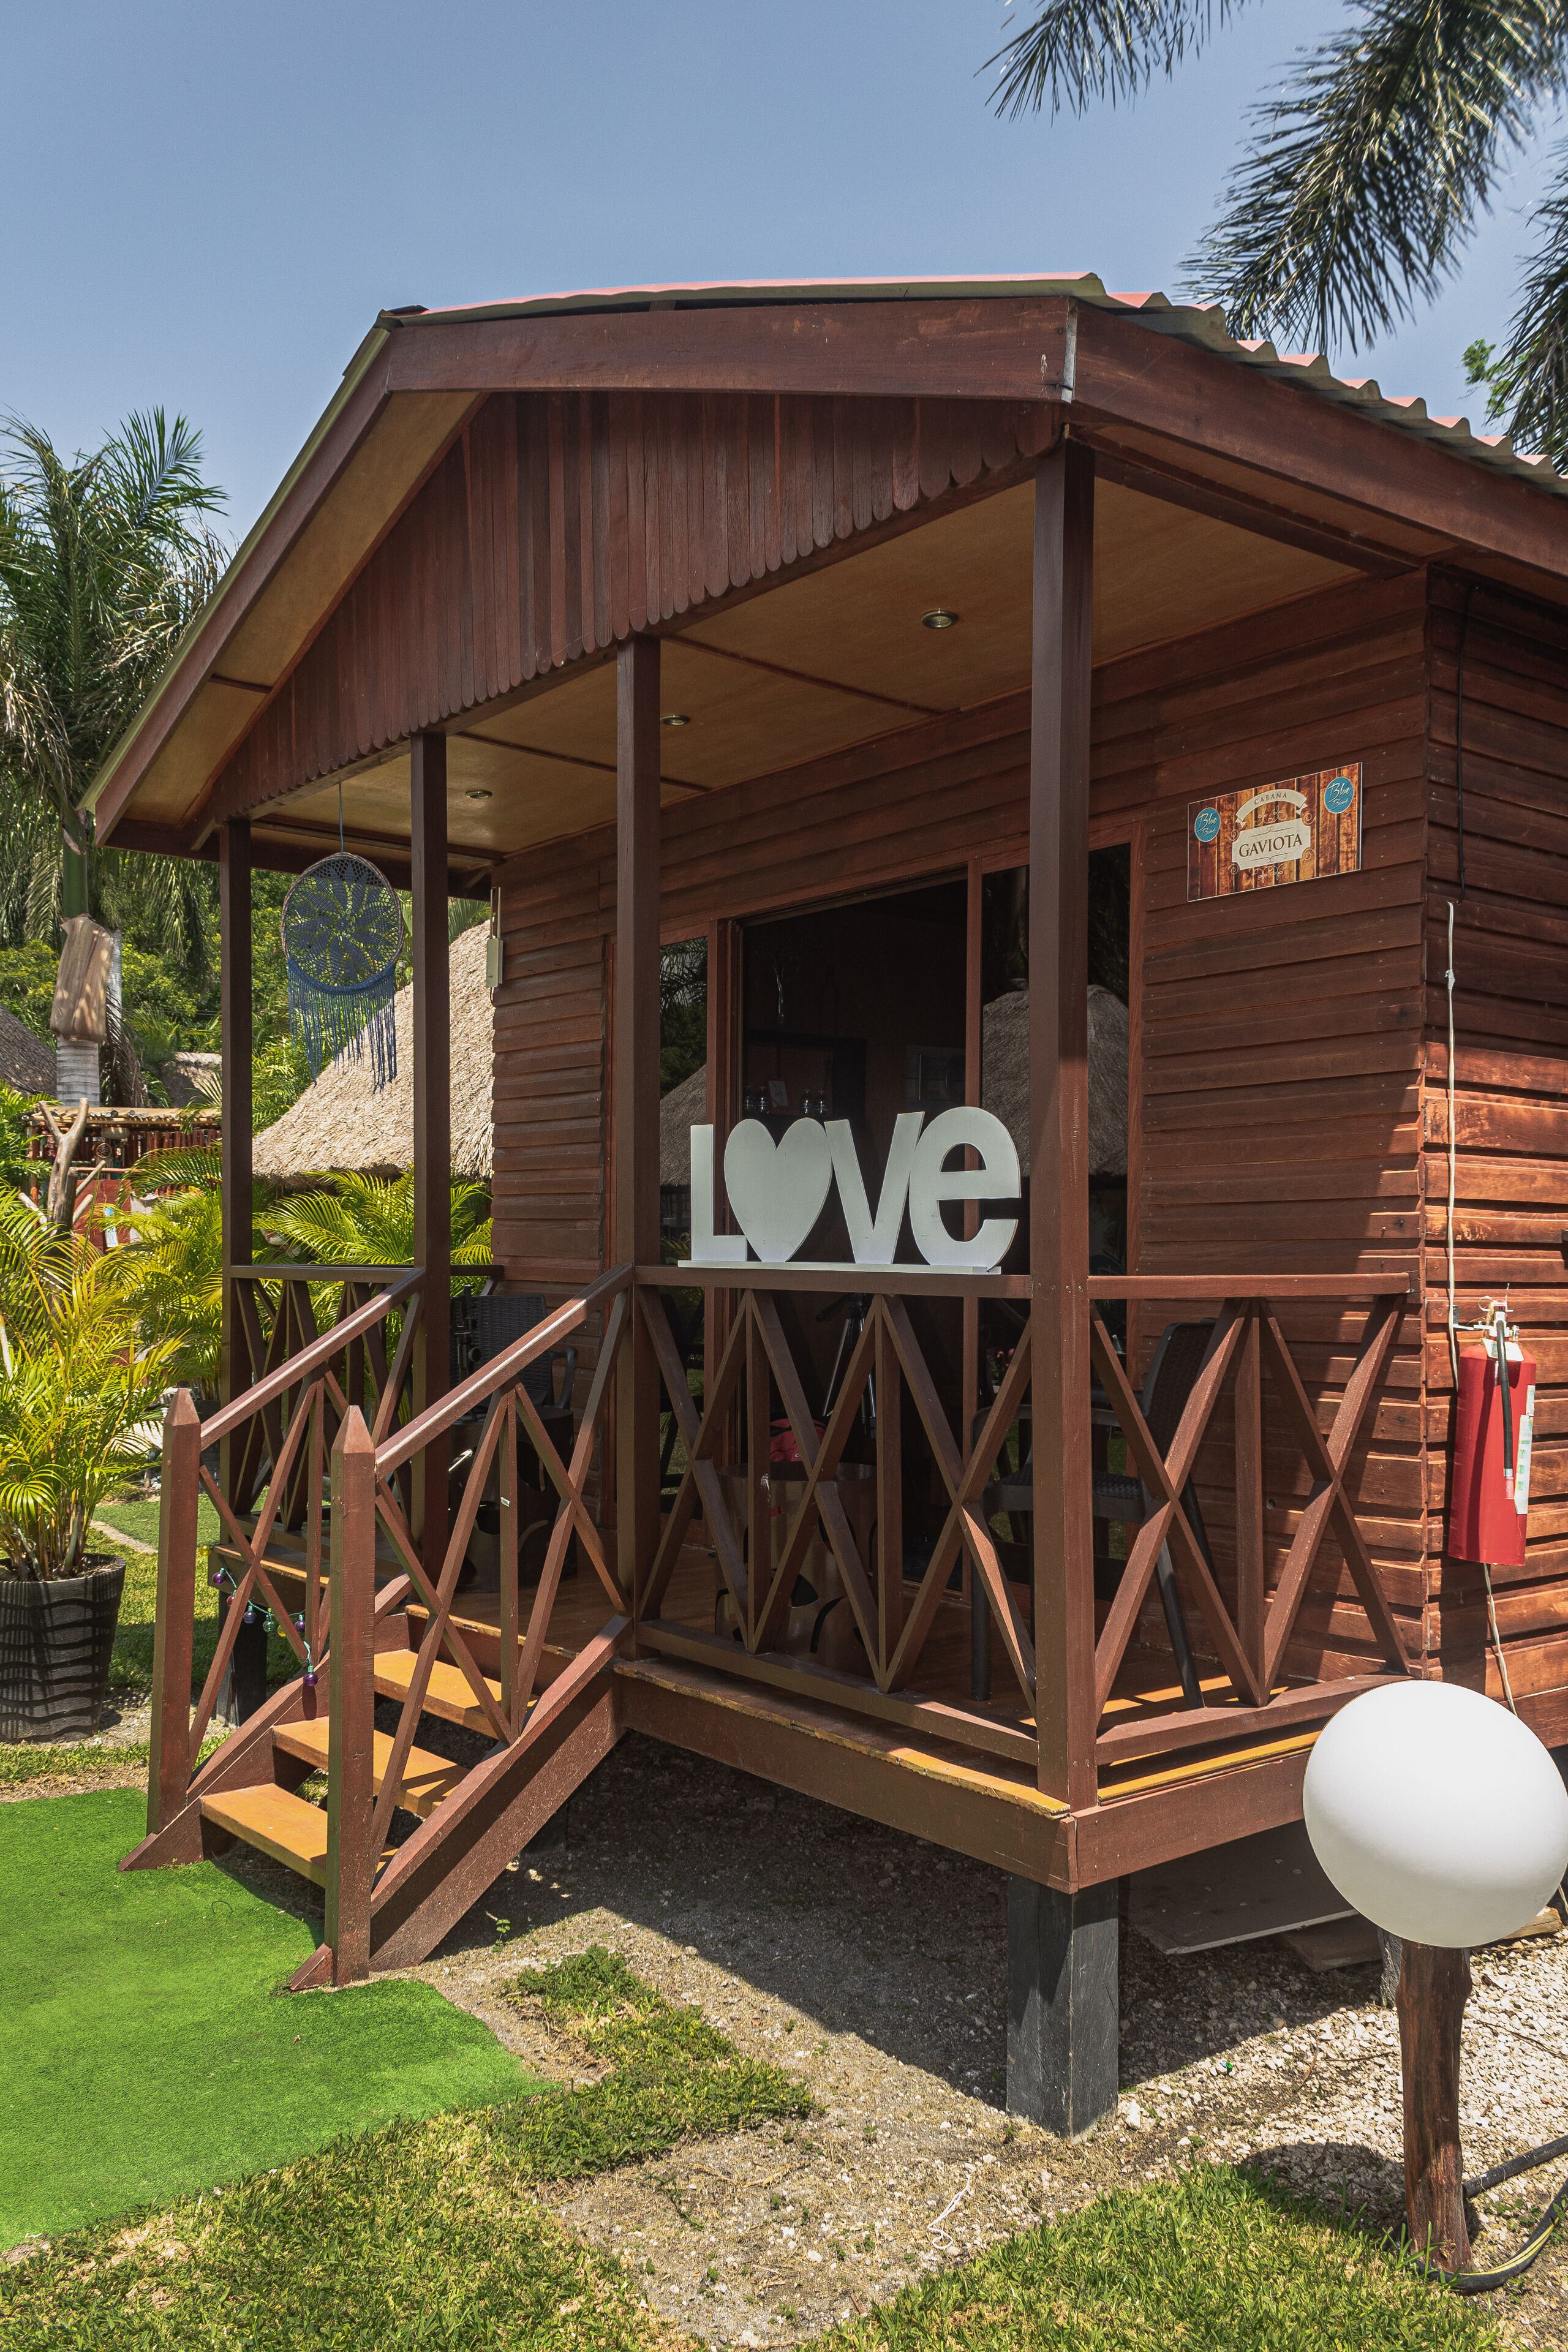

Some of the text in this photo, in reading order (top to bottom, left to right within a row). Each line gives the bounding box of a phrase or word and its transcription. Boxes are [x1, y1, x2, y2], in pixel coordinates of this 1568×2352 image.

[1253, 791, 1287, 805] CABAÑA
[1327, 782, 1352, 804] Blue
[1197, 813, 1218, 832] Blue
[1238, 833, 1303, 858] GAVIOTA
